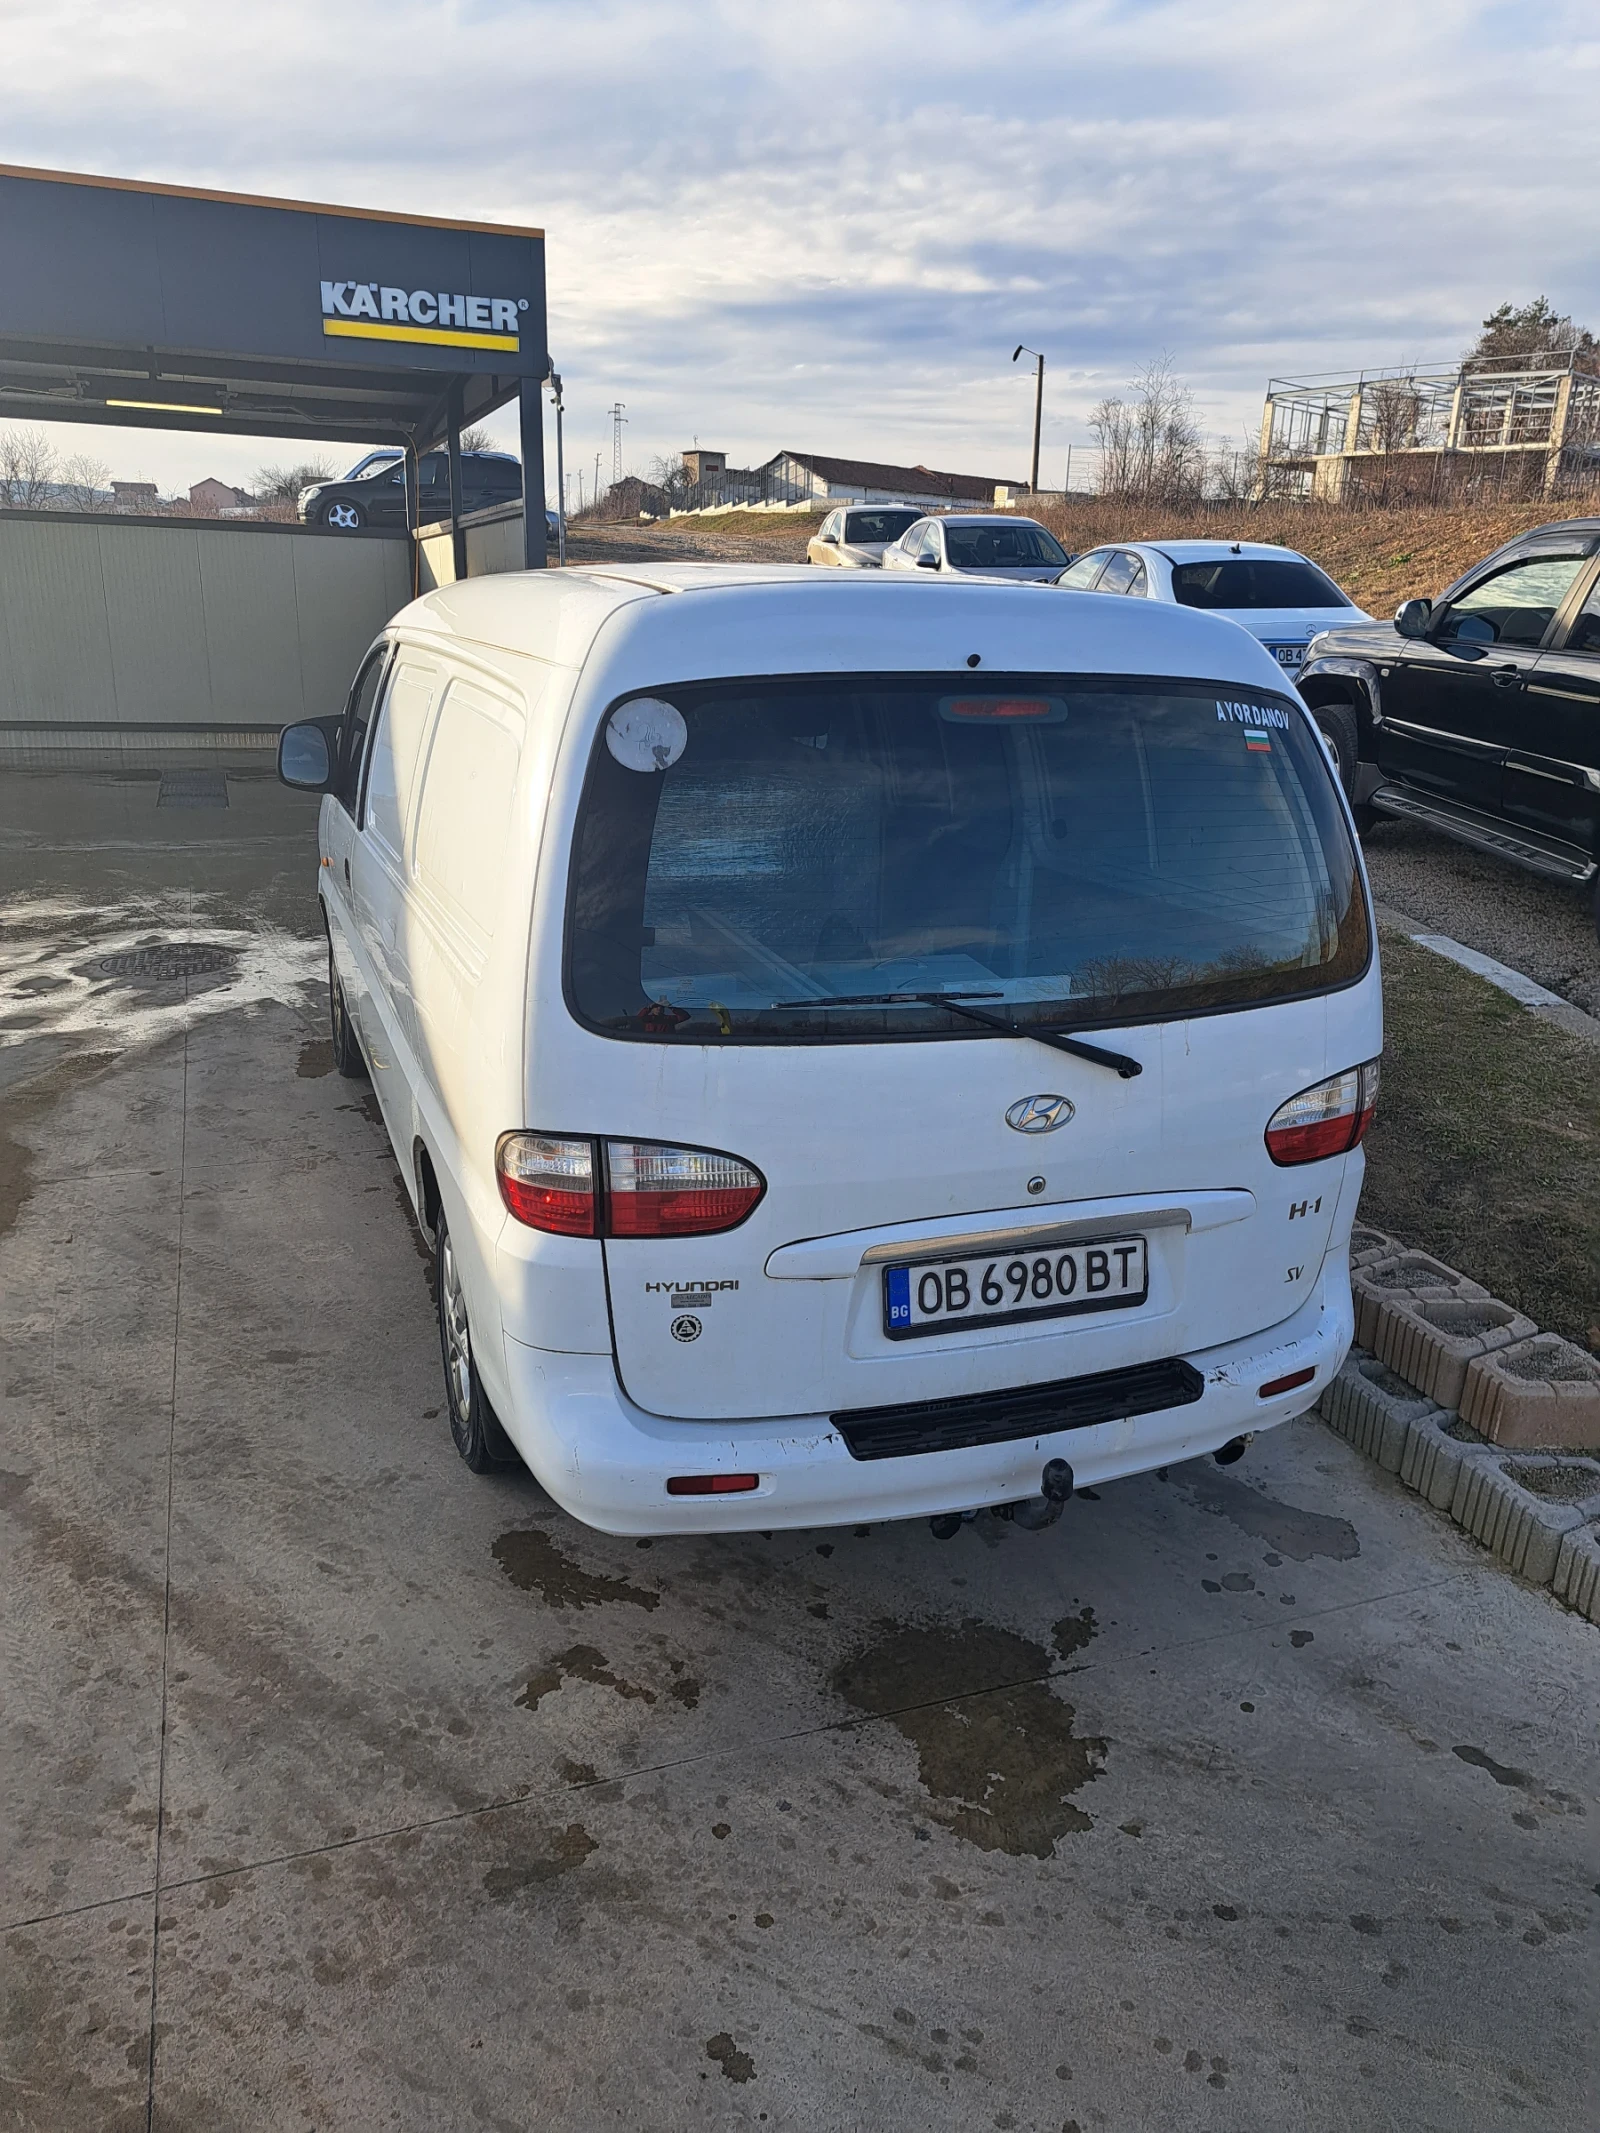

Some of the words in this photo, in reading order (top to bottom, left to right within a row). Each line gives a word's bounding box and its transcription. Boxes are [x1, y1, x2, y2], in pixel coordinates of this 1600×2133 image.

[1278, 649, 1293, 662] OB
[1289, 1195, 1322, 1220] H-1
[891, 1304, 908, 1319] BG
[917, 1267, 970, 1315] OB
[980, 1254, 1077, 1306] 6980
[1086, 1246, 1137, 1293] BT
[1284, 1264, 1304, 1283] SV
[645, 1280, 739, 1292] HYUNDAI
